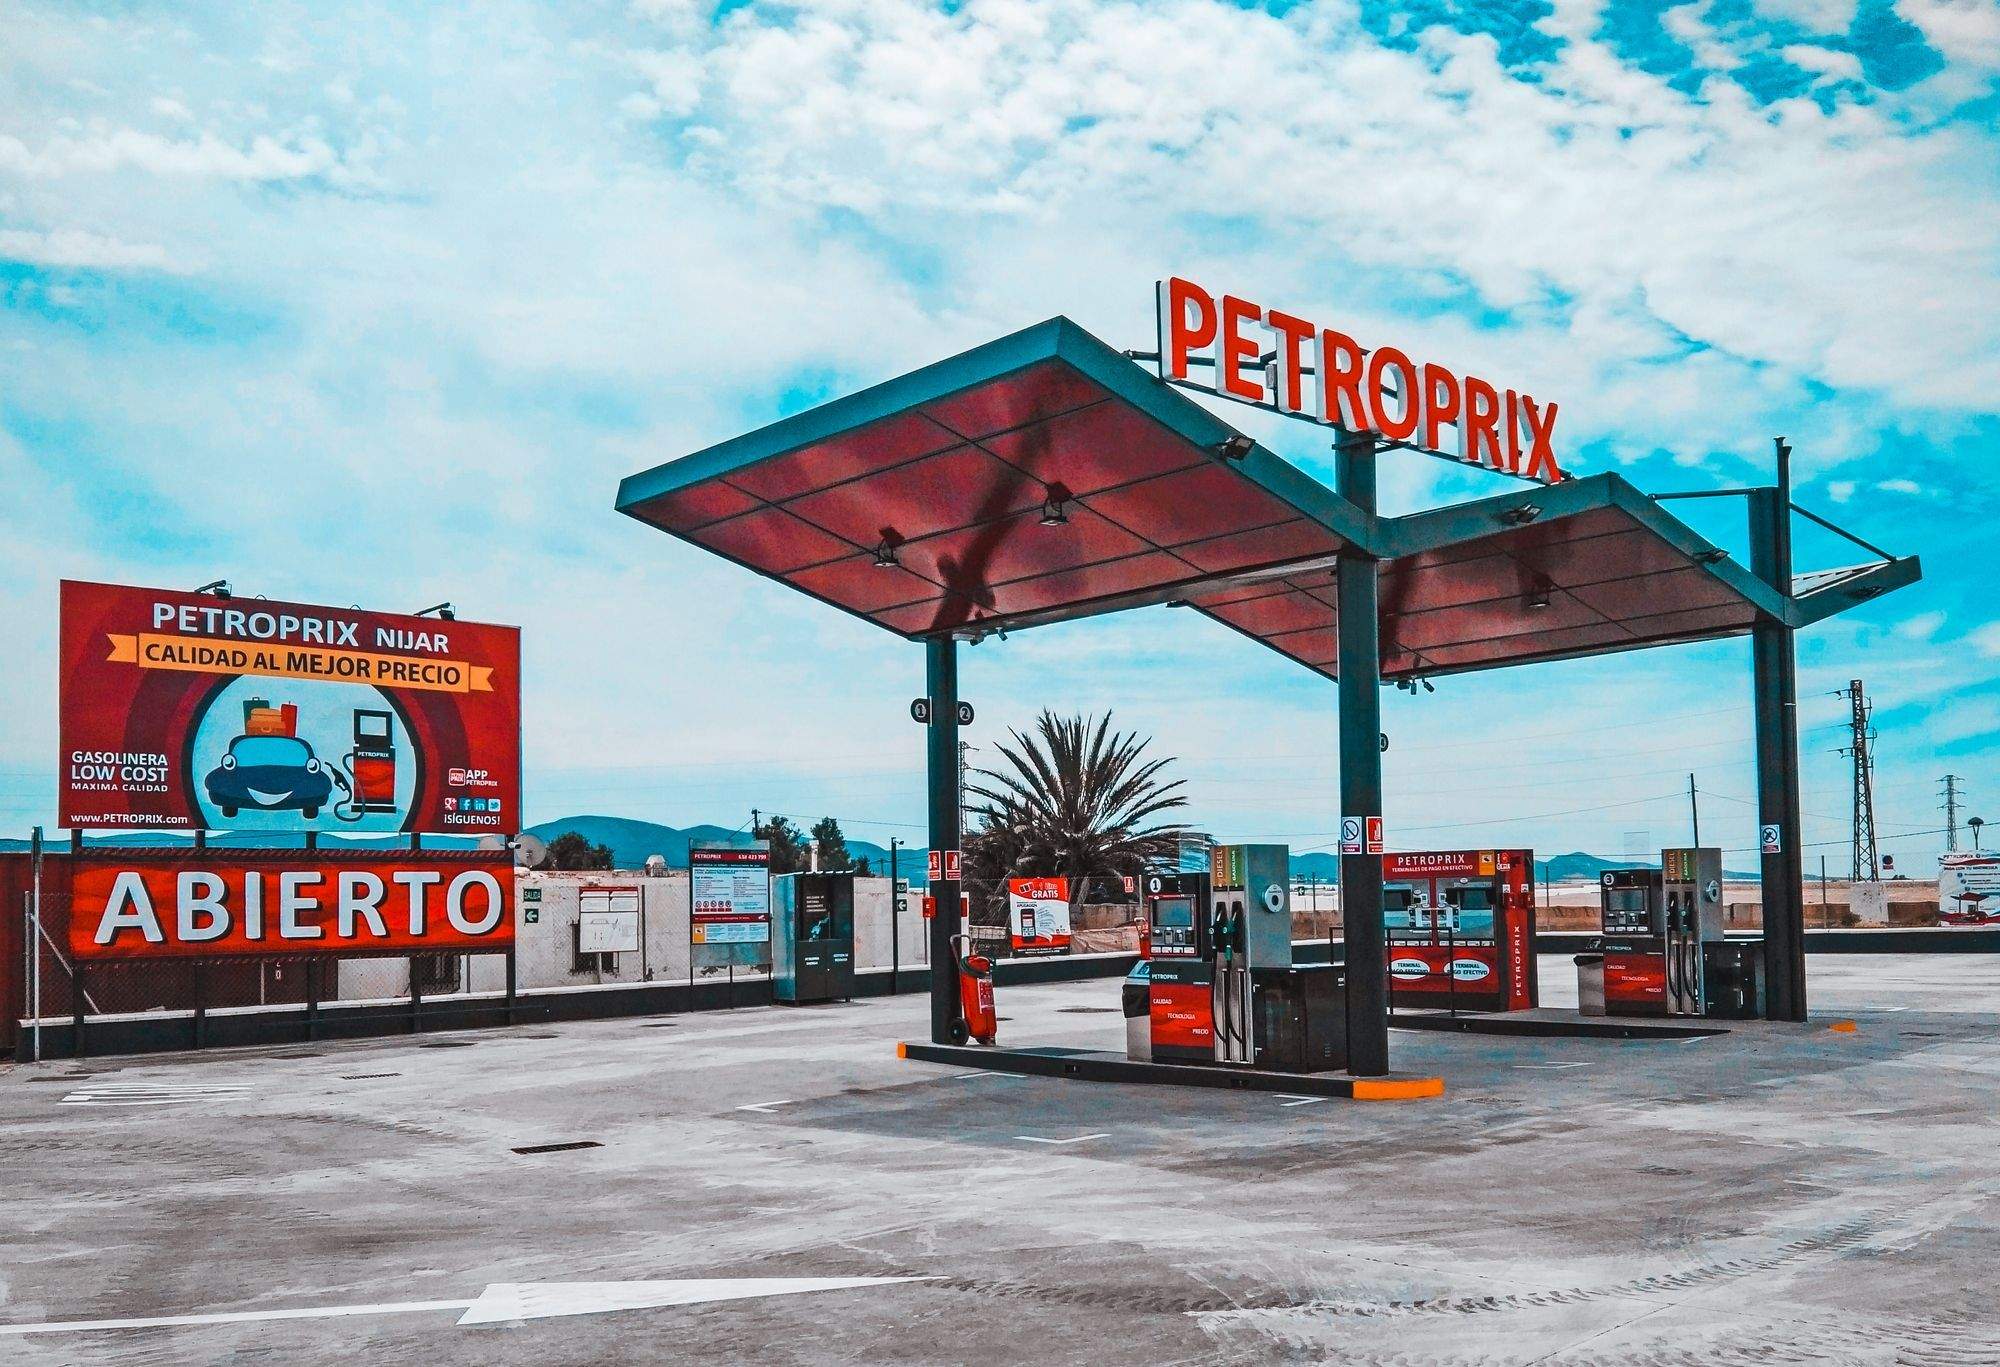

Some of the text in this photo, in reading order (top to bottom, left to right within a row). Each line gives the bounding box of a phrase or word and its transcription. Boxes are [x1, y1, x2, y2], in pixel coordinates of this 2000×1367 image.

[1165, 277, 1562, 485] PETROPRIX
[153, 602, 450, 653] PETROPRIX NIJAR
[145, 643, 461, 686] CALIDAD AL MEJOR PRECIO
[961, 708, 969, 719] 2
[71, 751, 168, 766] GASOLINERA
[71, 765, 169, 782] LOW COST
[466, 770, 488, 780] APP
[71, 783, 168, 792] MAXIMA CALIDAD
[71, 814, 188, 824] www.PETROPRIX.com
[444, 813, 500, 825] ¡SÍGUENOS!
[1216, 849, 1224, 878] DIESEL
[1398, 854, 1465, 866] PETROPRIX
[1668, 852, 1676, 874] DIESEL
[1031, 890, 1058, 898] GRATIS
[94, 871, 504, 945] ABIERTO
